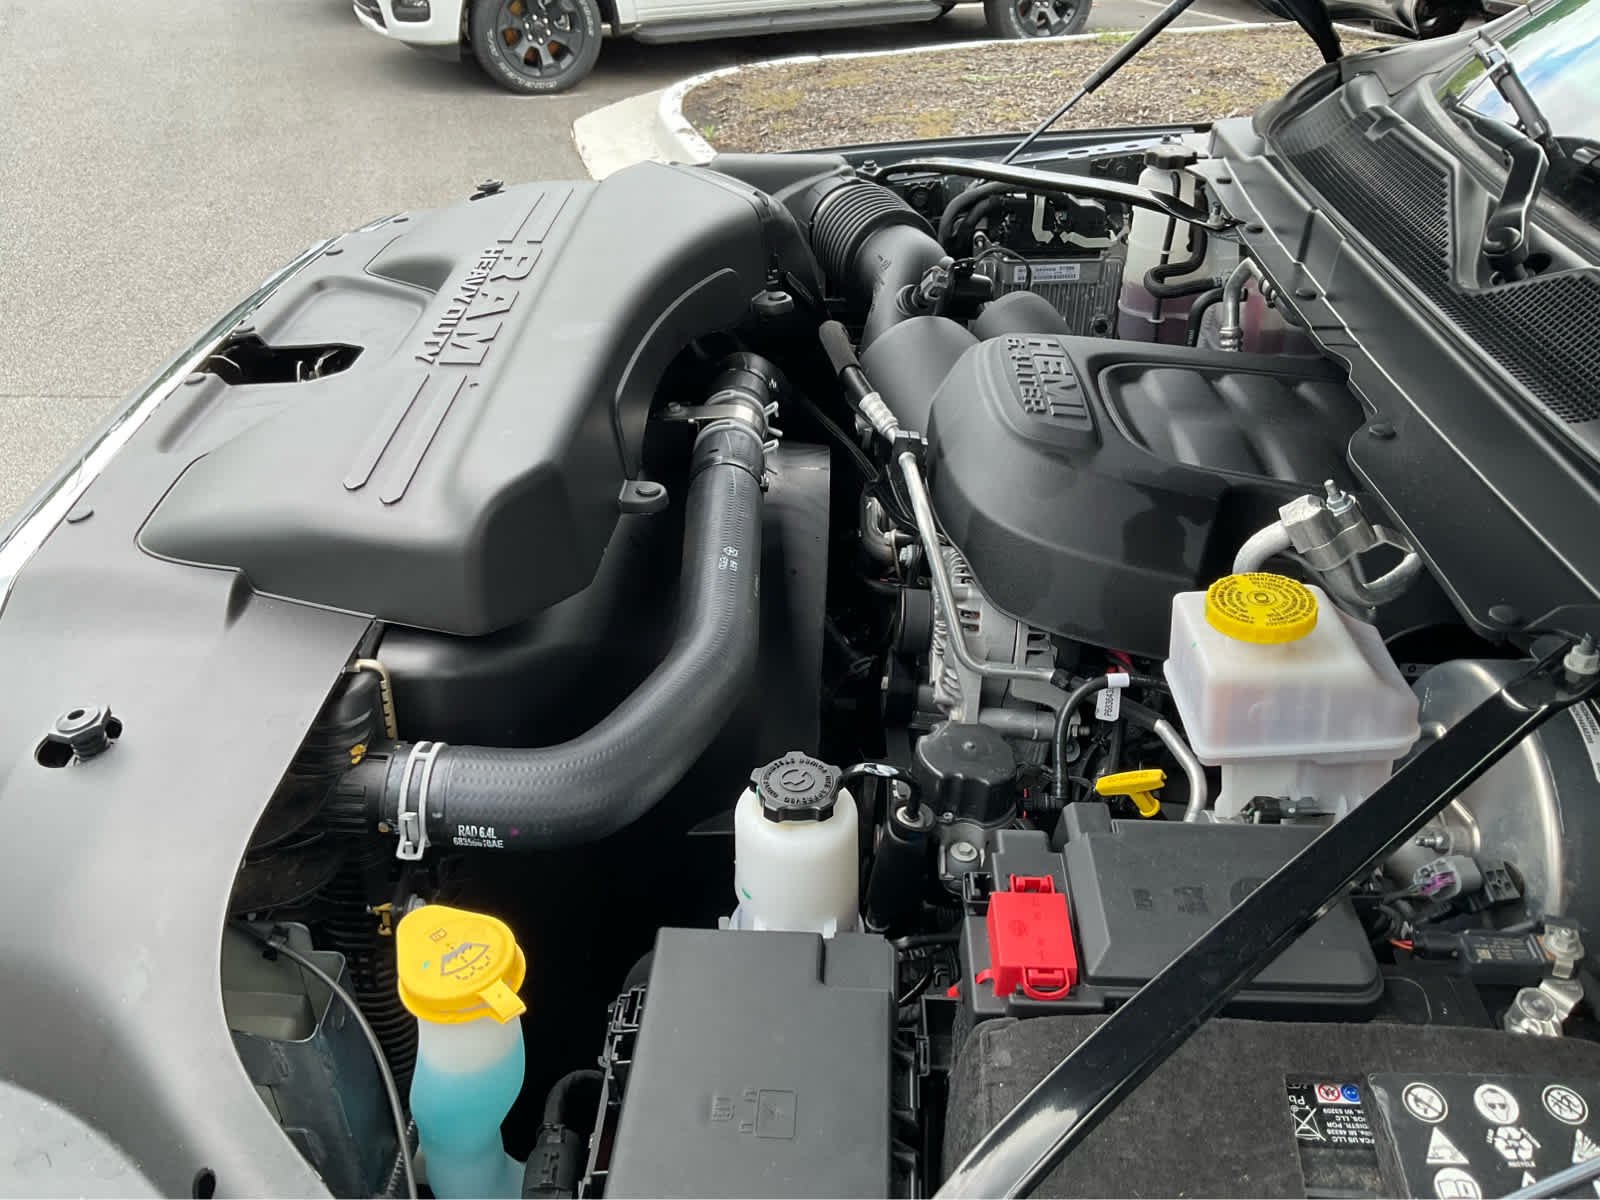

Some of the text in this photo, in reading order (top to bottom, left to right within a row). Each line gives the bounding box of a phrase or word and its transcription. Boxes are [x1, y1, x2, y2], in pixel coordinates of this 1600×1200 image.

[414, 248, 505, 365] HEAVY DUTY
[438, 247, 543, 366] RAM
[1016, 363, 1047, 414] LITER
[1028, 339, 1087, 419] HEMI
[457, 825, 497, 838] RAD 6.4L
[1288, 1095, 1306, 1105] Pb
